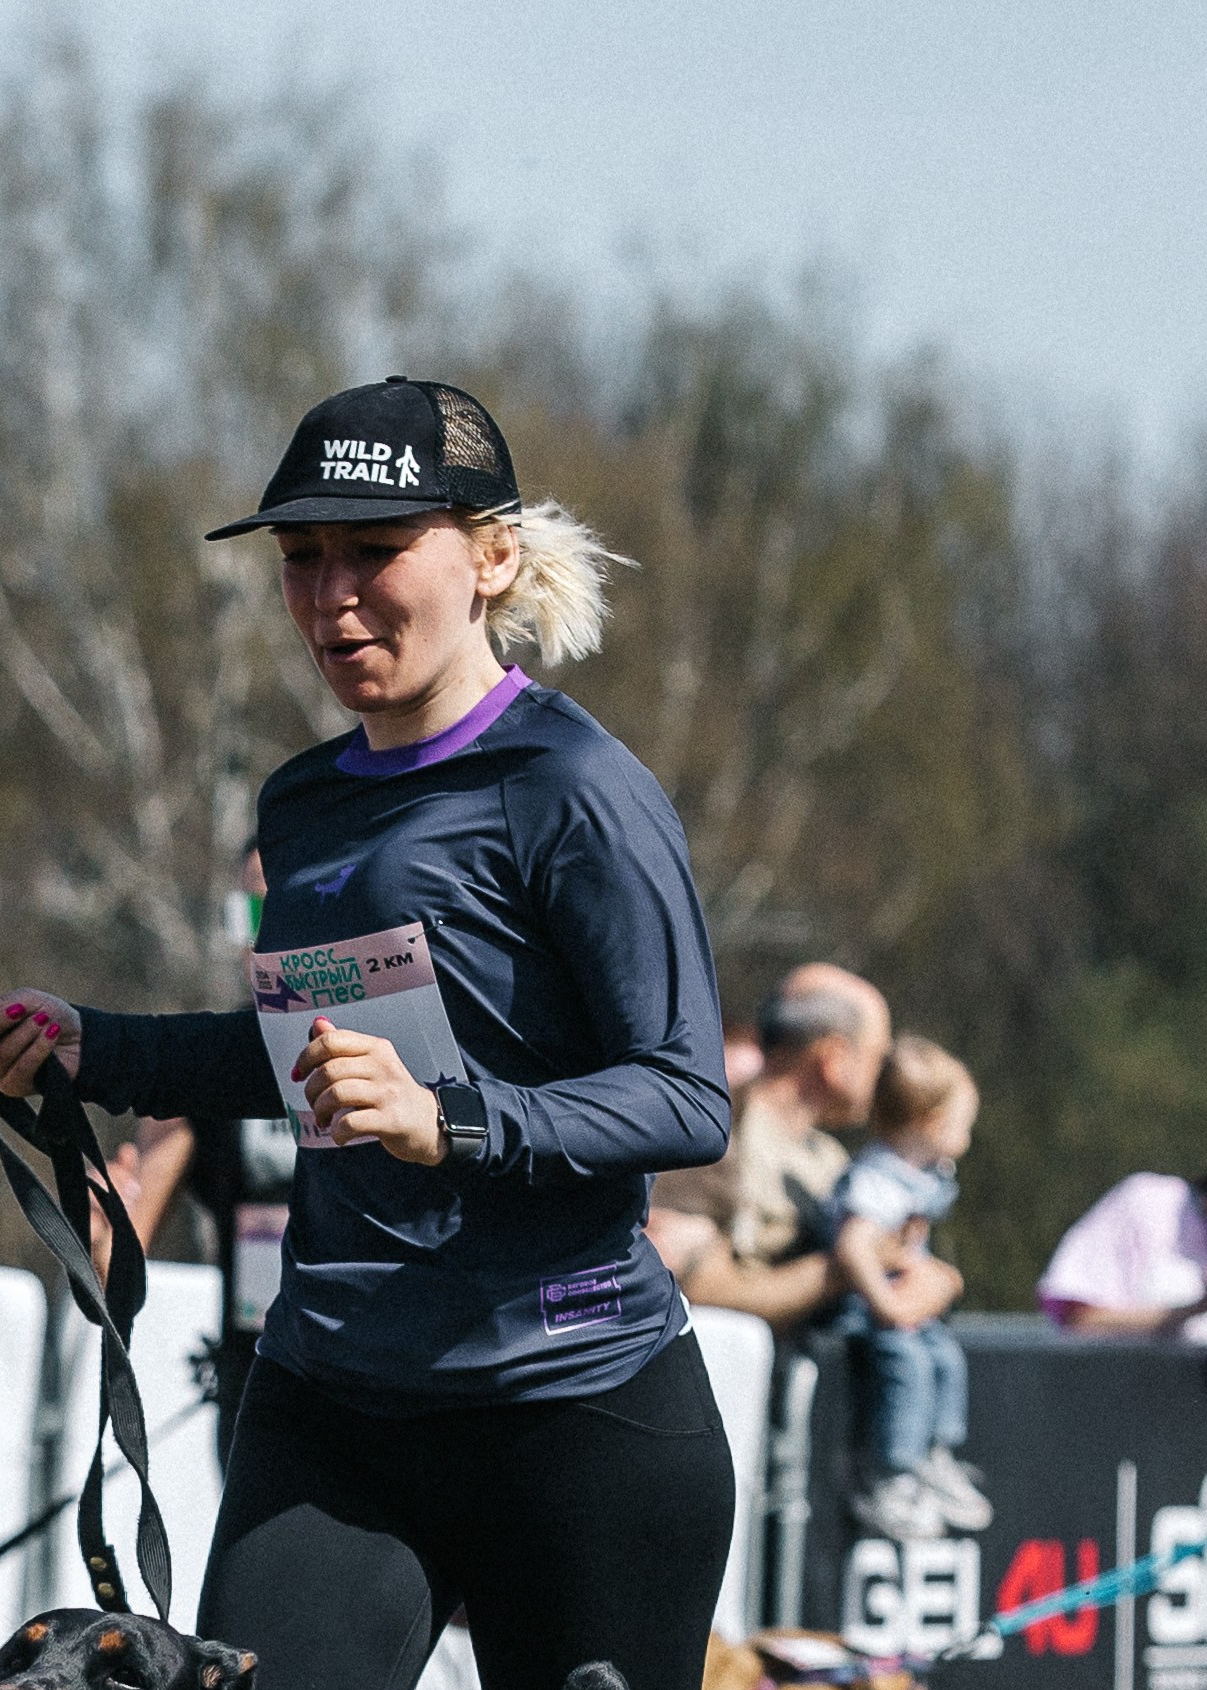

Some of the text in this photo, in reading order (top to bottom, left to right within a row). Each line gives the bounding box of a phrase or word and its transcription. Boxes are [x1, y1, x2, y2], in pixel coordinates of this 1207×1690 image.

[323, 439, 392, 461] WILD
[320, 461, 394, 486] TRAIL
[280, 948, 337, 973] КРОСС
[366, 958, 380, 973] 2
[555, 1301, 611, 1323] INSANITY
